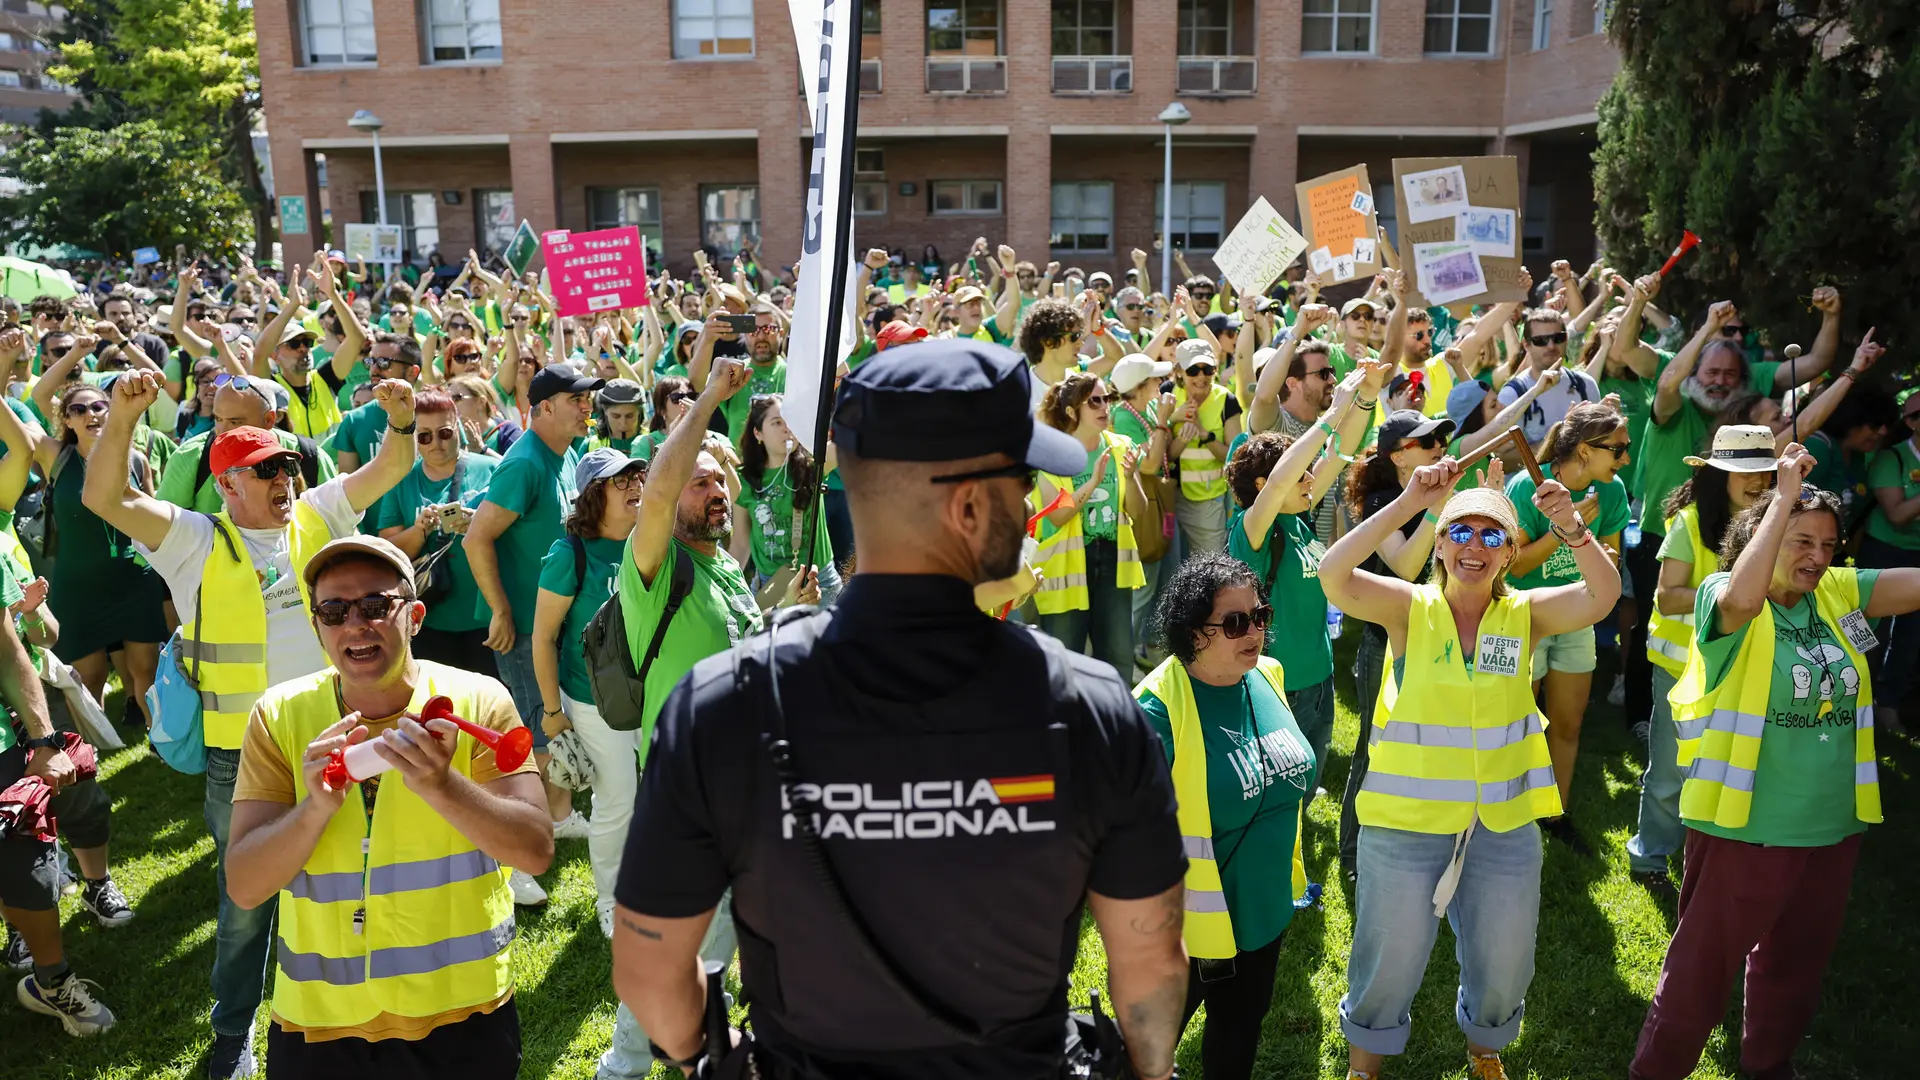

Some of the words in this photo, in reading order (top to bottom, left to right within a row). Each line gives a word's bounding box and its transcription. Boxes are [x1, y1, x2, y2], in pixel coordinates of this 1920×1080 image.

[1471, 172, 1500, 195] JA
[1839, 618, 1849, 629] JO
[1846, 611, 1863, 627] ESTIC
[1849, 623, 1860, 633] DE
[1483, 636, 1495, 646] JO
[1495, 637, 1519, 649] ESTIC
[1849, 627, 1874, 646] VAGA
[1494, 646, 1506, 655] DE
[1479, 664, 1515, 675] INDEFINIDA
[1482, 652, 1516, 669] VAGA
[1243, 786, 1260, 800] NO
[1279, 762, 1313, 780] TOCA
[781, 778, 1001, 810] POLICIA
[782, 806, 1056, 839] NACIONAL
